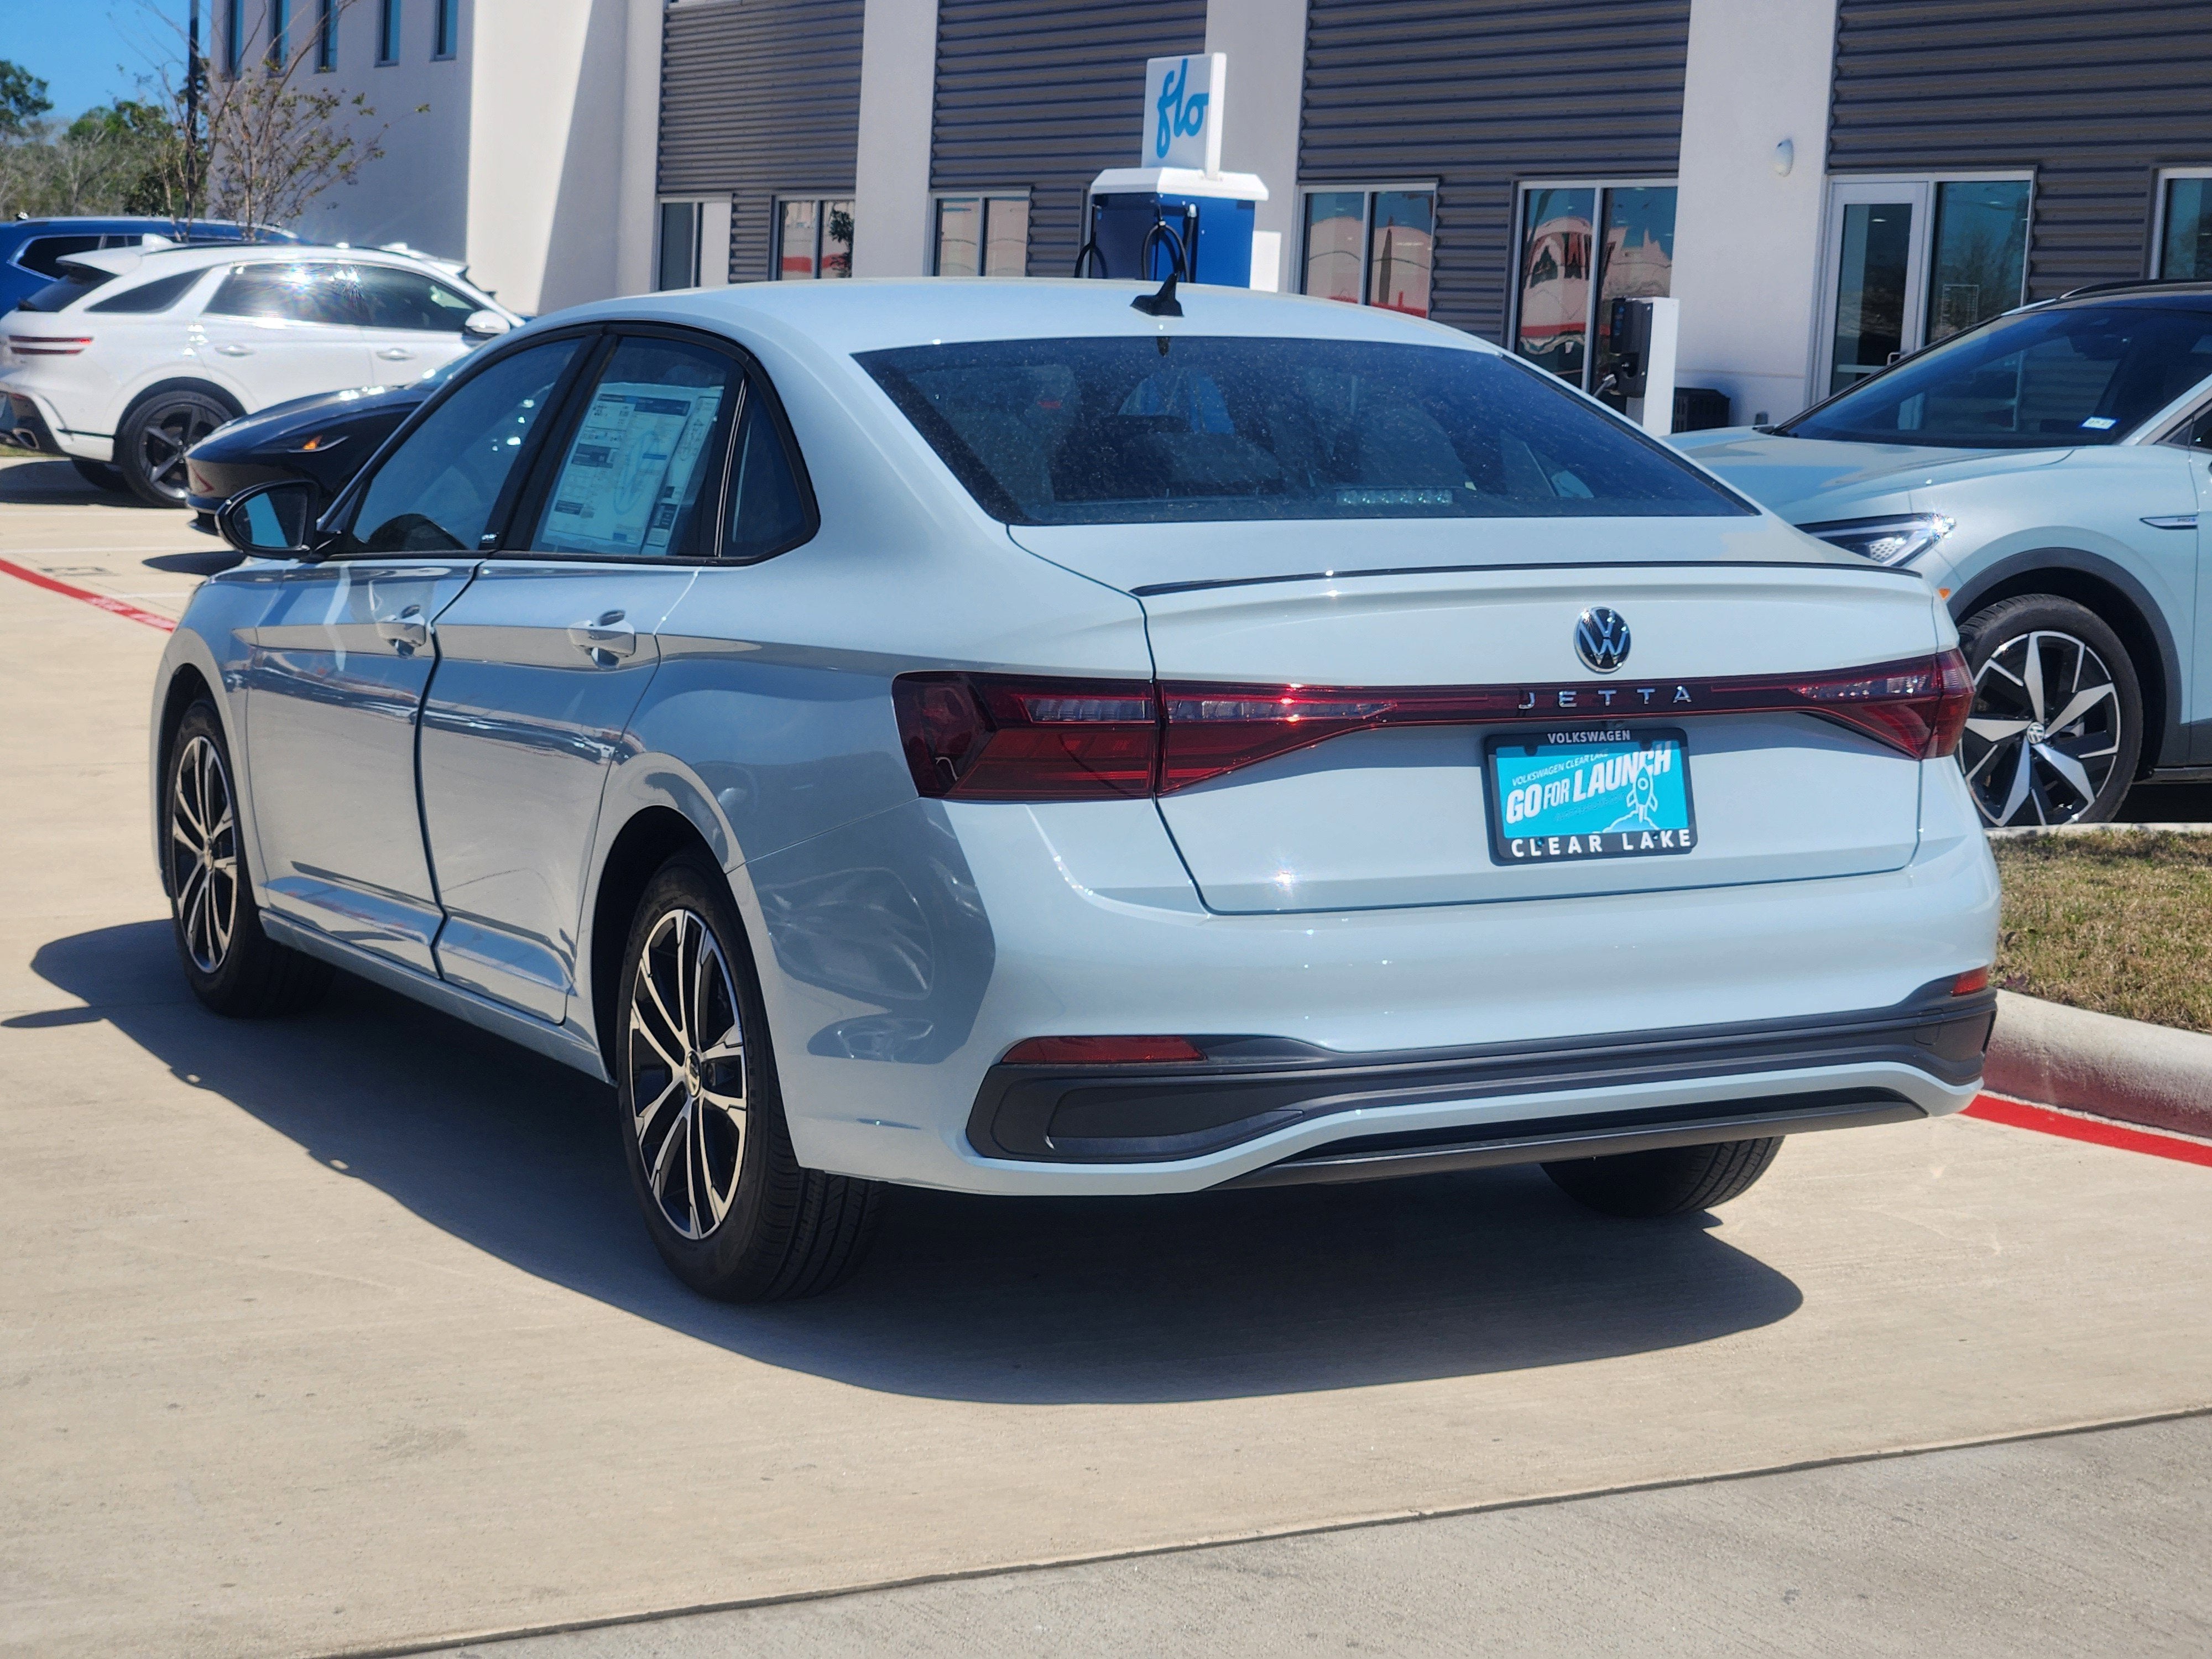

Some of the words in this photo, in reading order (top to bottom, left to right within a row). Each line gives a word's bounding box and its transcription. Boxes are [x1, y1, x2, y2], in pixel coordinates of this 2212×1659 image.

[1156, 58, 1209, 158] flo
[1518, 685, 1692, 709] JETTA
[1547, 729, 1631, 744] VOLKSWAGEN
[1506, 783, 1543, 824] GO
[1543, 778, 1571, 810] FOR
[1572, 741, 1672, 802] LAUNCH
[1512, 762, 1565, 786] VOLKSWAGEN
[1566, 755, 1590, 769] CLEAR
[1511, 835, 1603, 857] CLEAR
[1621, 828, 1691, 851] LAKE
